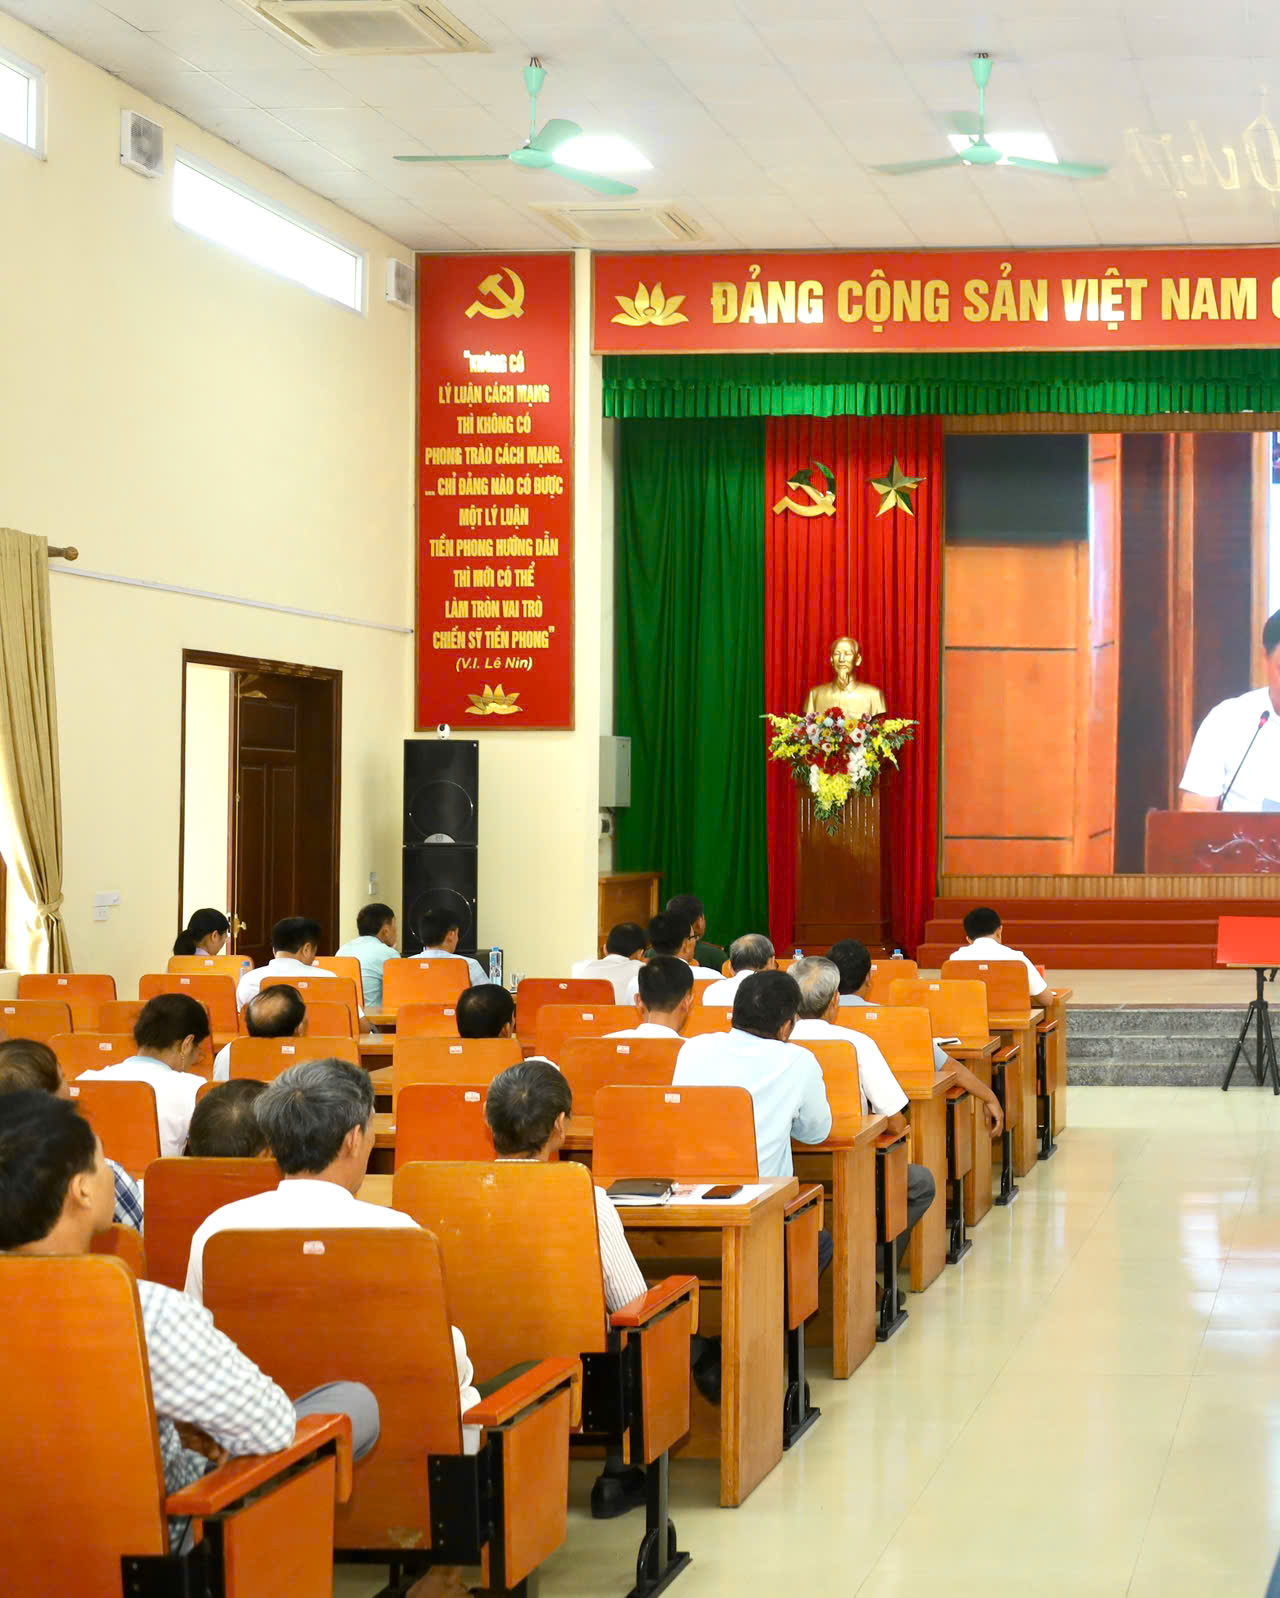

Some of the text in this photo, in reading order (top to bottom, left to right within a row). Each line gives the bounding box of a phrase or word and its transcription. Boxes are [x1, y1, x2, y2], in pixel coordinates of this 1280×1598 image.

[710, 264, 824, 324] ĐẢNG
[837, 269, 950, 333] CỘNG
[963, 262, 1048, 322] SẢN
[1062, 267, 1148, 330] VIỆT
[1161, 277, 1257, 321] NAM
[509, 350, 525, 373] CÓ
[438, 381, 550, 408] LÝ LUẬN CÁCH MẠNG
[457, 412, 531, 434] THÌ KHÔNG CÓ
[425, 443, 563, 468] PHONG TRÀO CÁCH MẠNG.
[437, 471, 456, 495] CHỈ
[458, 471, 488, 495] ĐẢNG
[491, 473, 514, 495] NÀO
[516, 472, 532, 495] CÓ
[533, 475, 563, 499] ĐƯỢC
[459, 504, 529, 530] MỘT LÝ LUẬN
[456, 539, 493, 556] PHONG
[535, 530, 558, 556] DẪN
[453, 566, 470, 587] THÌ
[497, 565, 512, 587] CÓ
[514, 561, 536, 587] THỂ
[445, 595, 543, 618] LÀM TRÒN VAI TRÒ
[433, 625, 466, 649] CHIẾN
[468, 627, 482, 649] SỸ
[456, 657, 533, 672] (V.I. Lê Nin)
